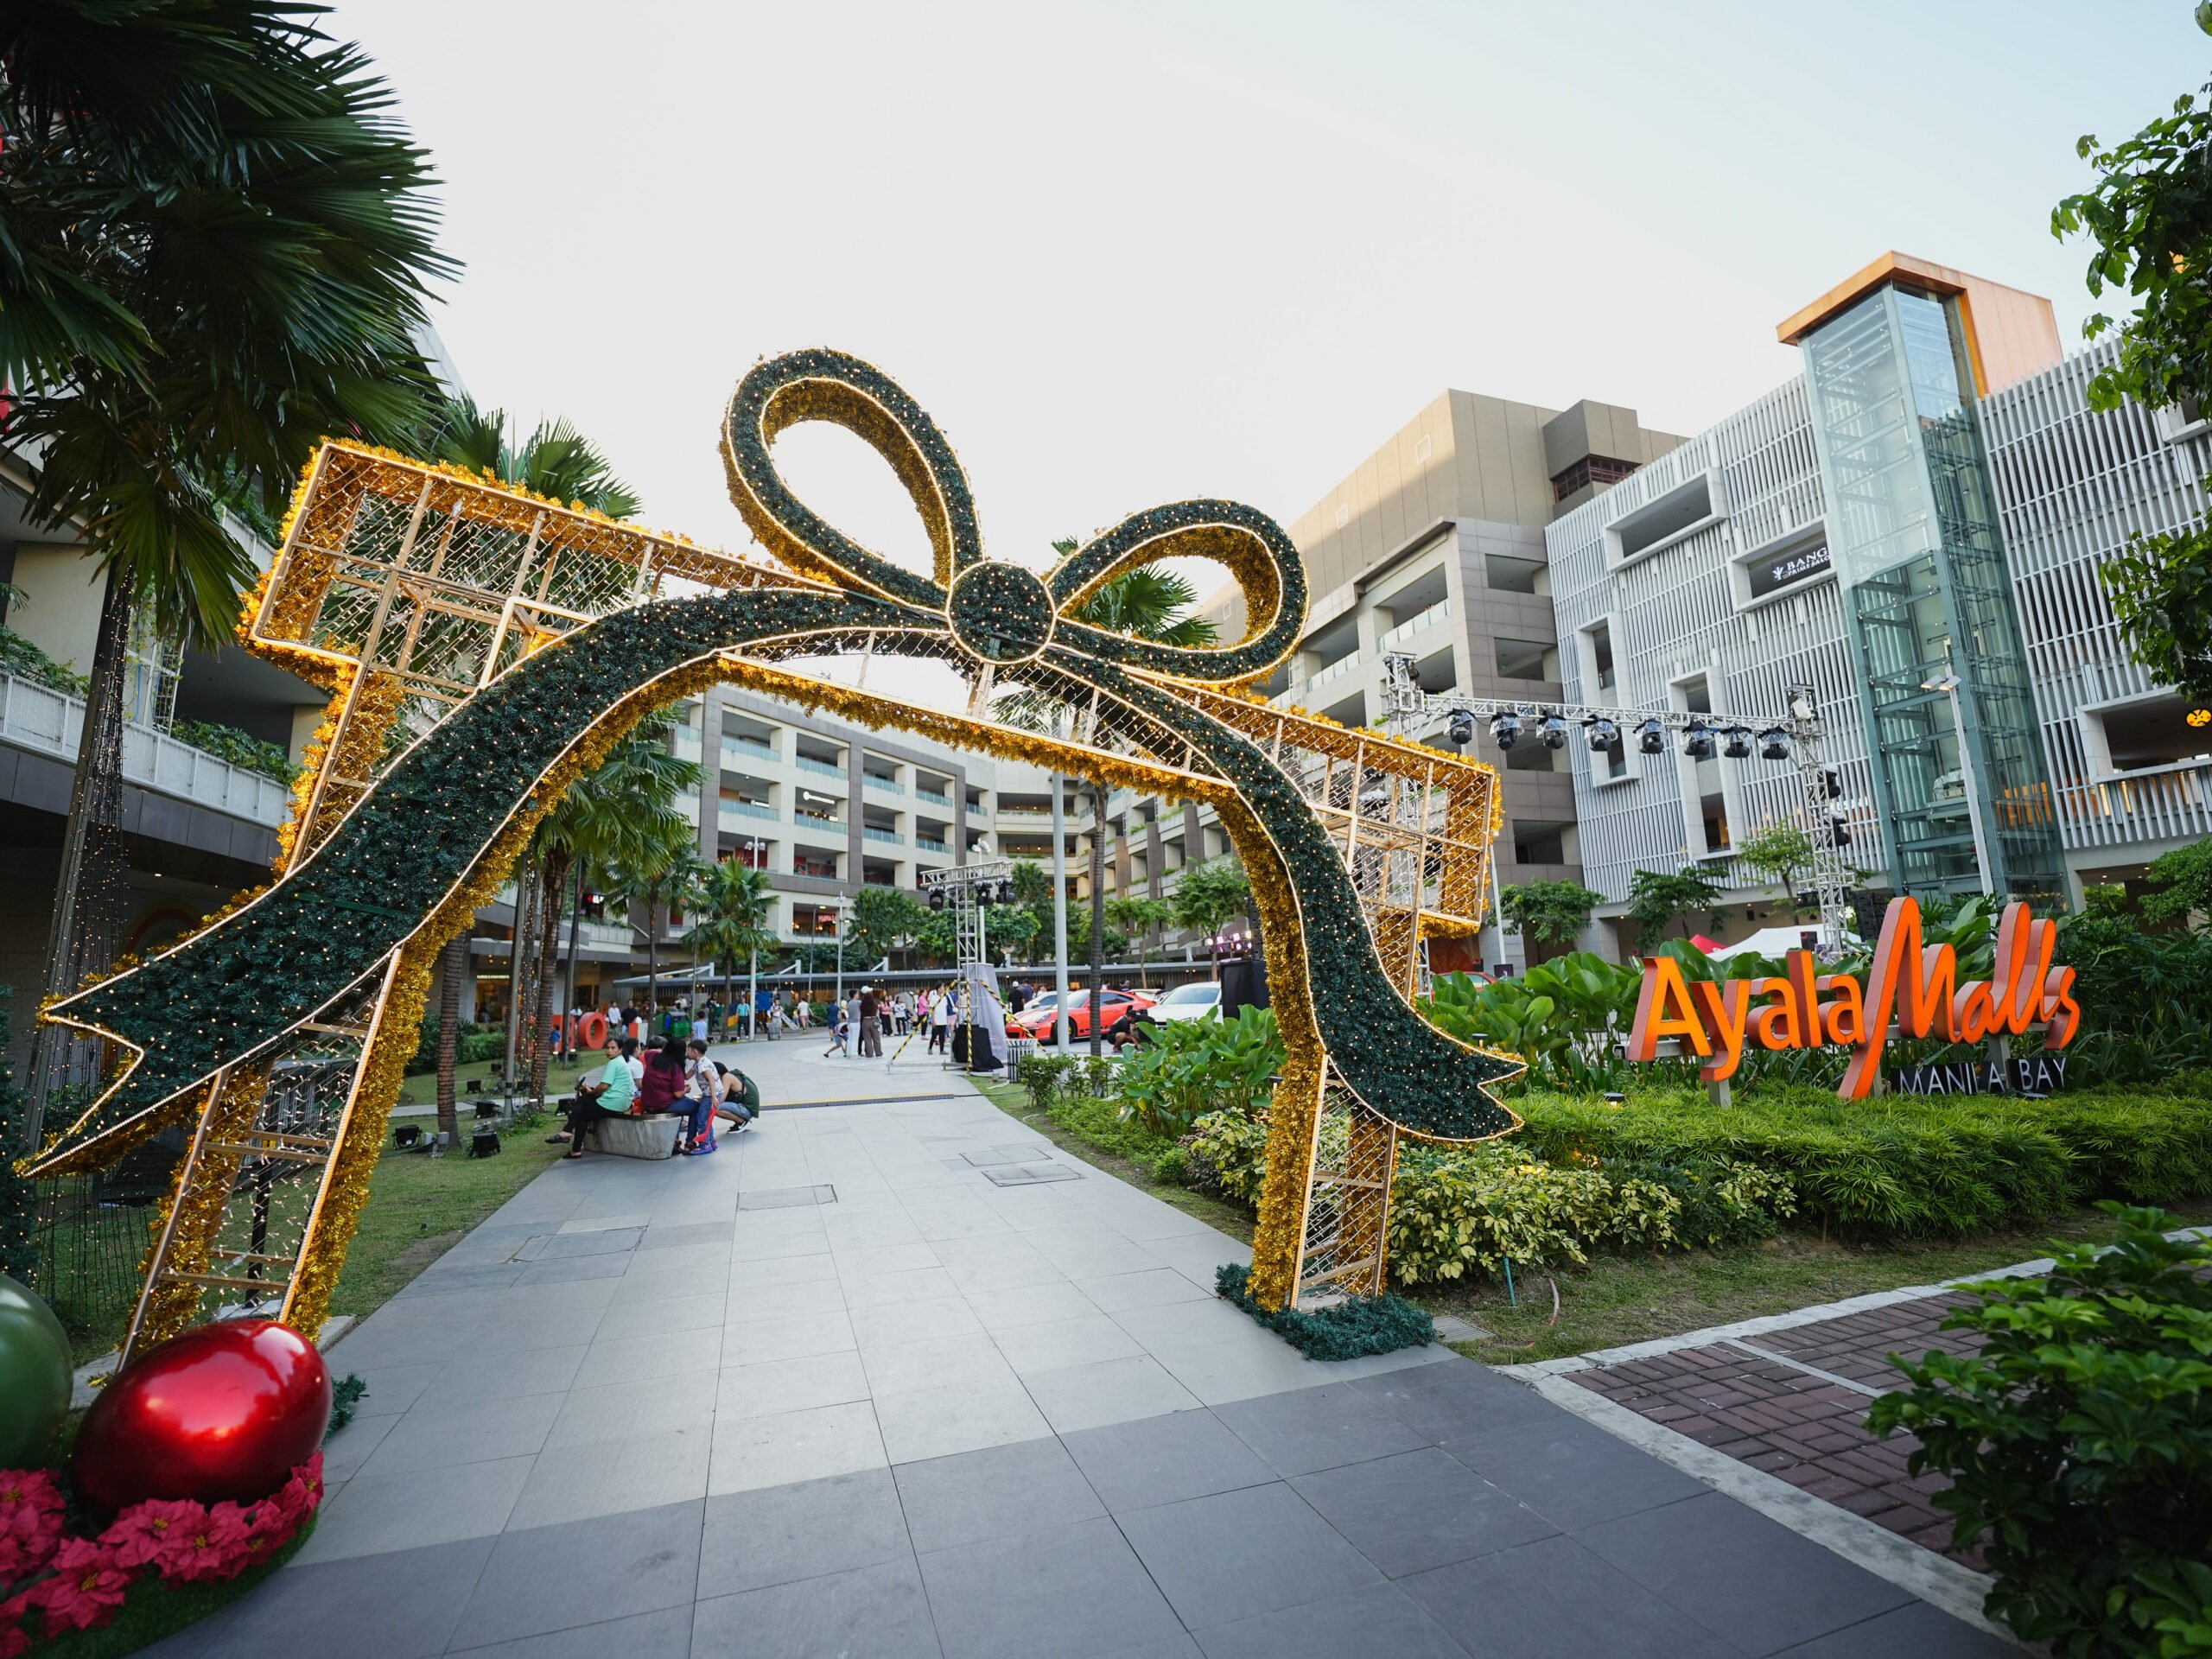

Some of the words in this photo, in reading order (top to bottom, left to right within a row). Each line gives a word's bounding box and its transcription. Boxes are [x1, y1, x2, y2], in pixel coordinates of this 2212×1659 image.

[1627, 950, 1866, 1082] Ayala
[1837, 896, 2081, 1102] Malls
[1899, 1061, 2006, 1096] MANILA
[2018, 1057, 2067, 1091] BAY
